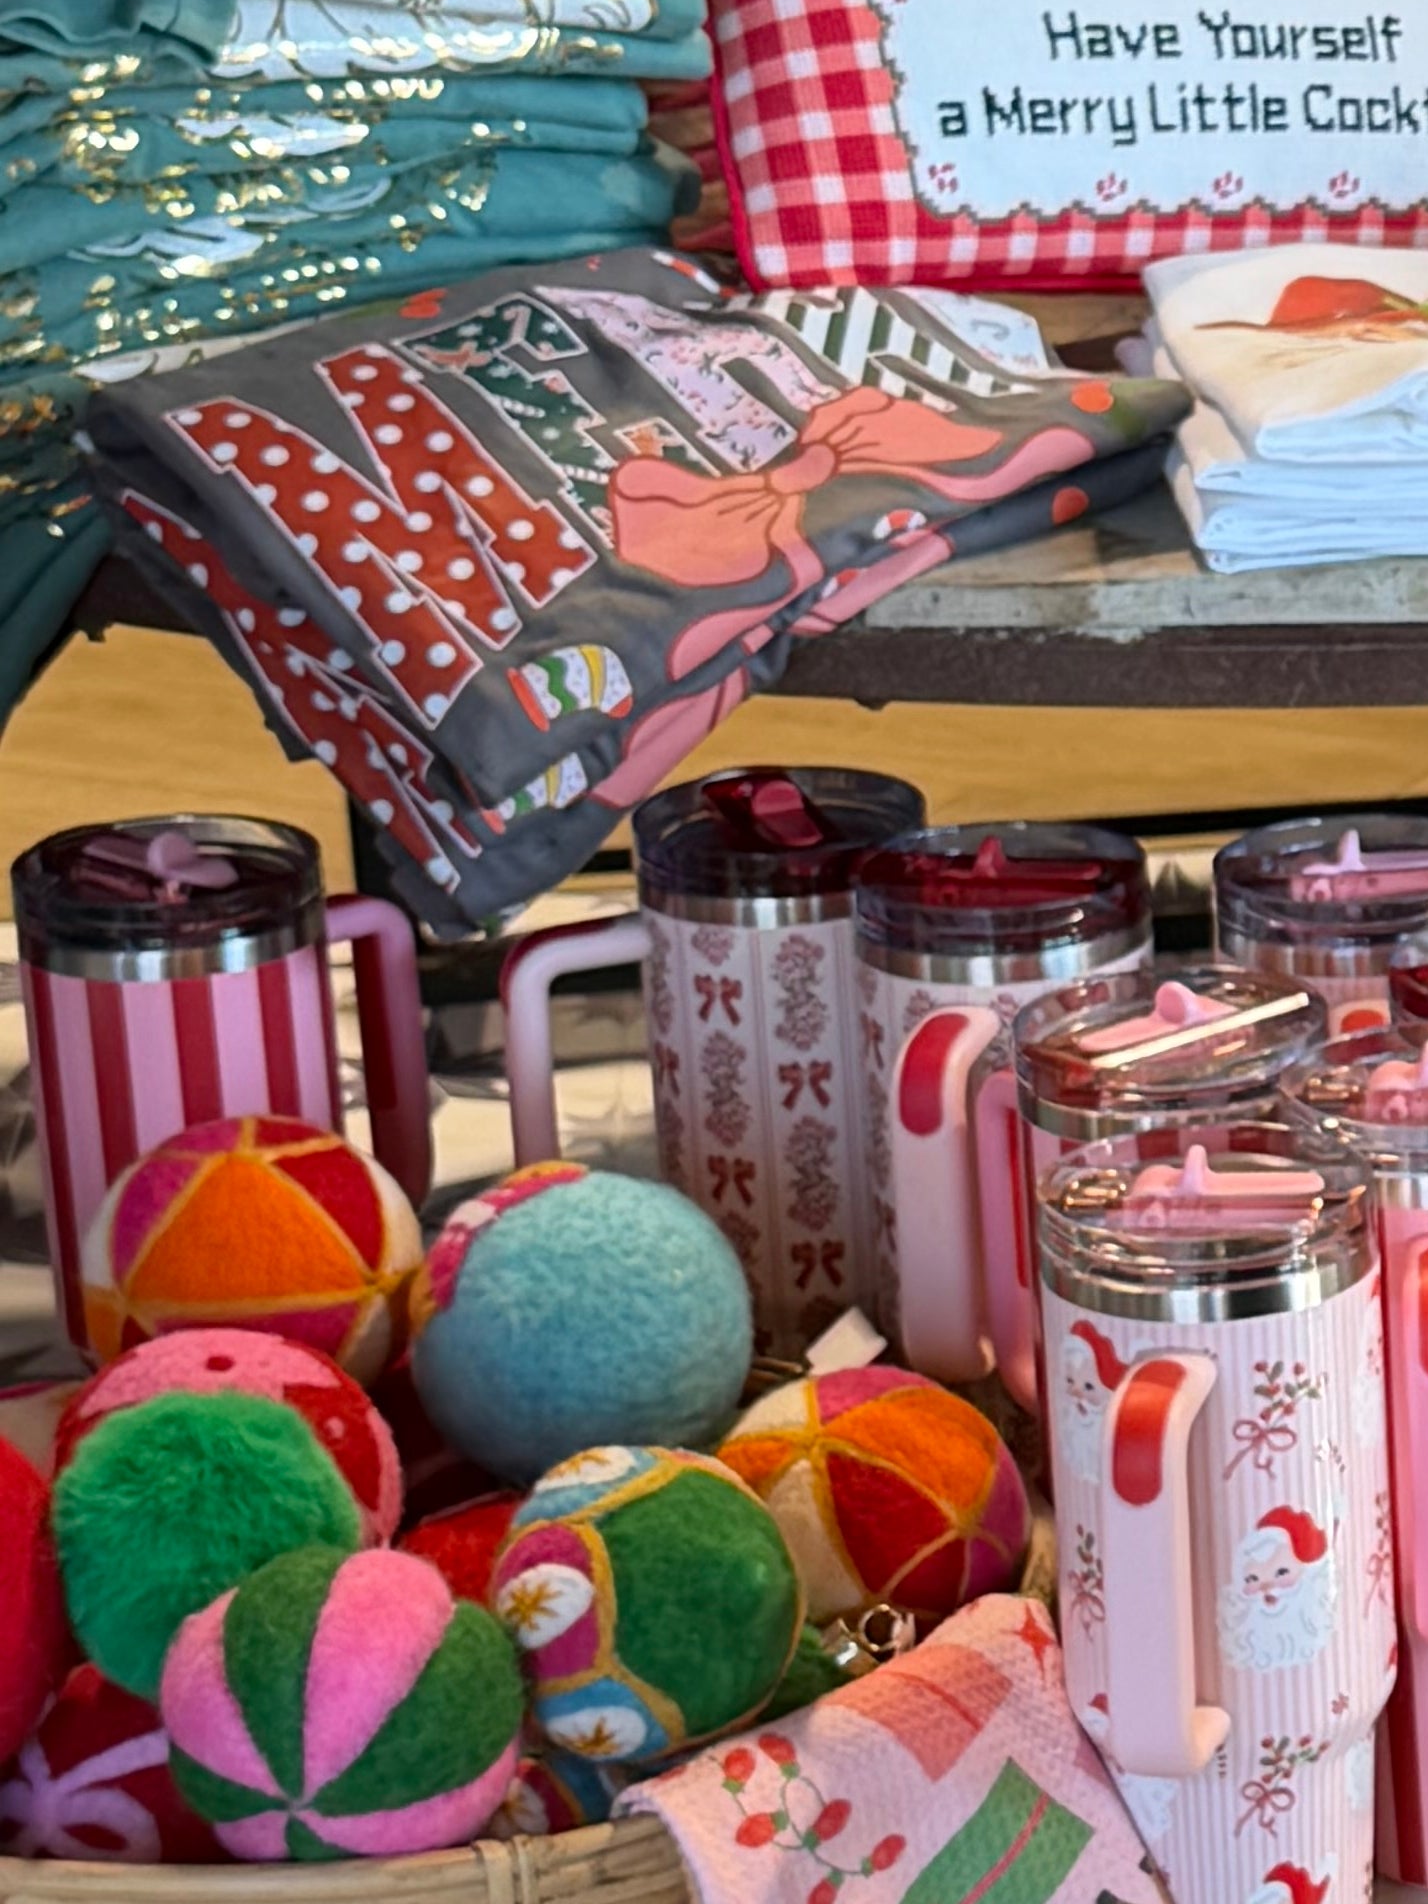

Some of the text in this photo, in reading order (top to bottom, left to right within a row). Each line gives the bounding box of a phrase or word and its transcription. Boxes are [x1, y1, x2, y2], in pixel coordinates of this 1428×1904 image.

[1042, 10, 1403, 63] Have Yourself
[937, 98, 969, 138] a
[982, 85, 1138, 147] Merry
[1147, 81, 1289, 135] Little
